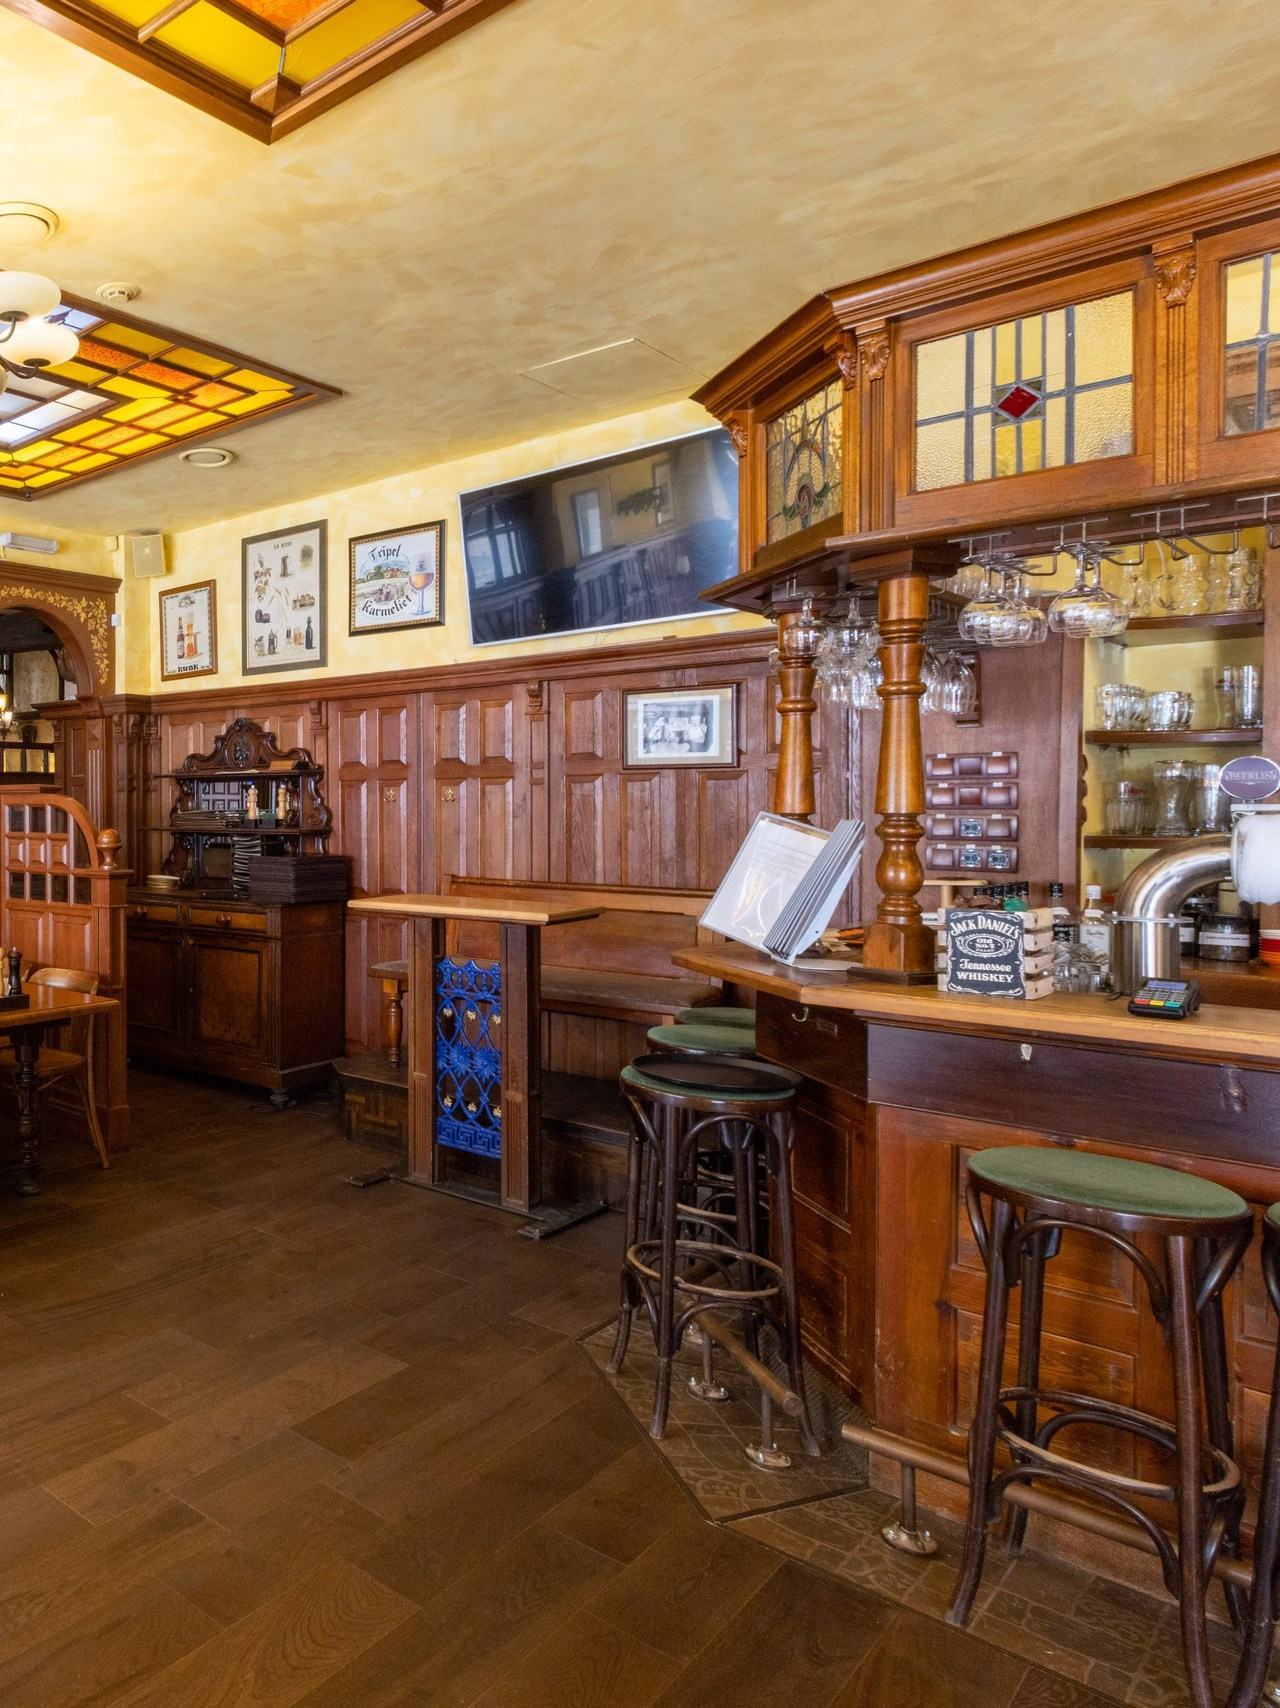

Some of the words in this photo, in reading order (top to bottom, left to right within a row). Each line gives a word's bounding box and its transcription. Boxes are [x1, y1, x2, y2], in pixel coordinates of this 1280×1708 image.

[368, 544, 402, 561] Tripel
[361, 595, 412, 617] Karmeliet
[950, 919, 975, 936] JACK
[977, 915, 1022, 939] DANIEL'S
[959, 958, 1012, 972] Tennessee
[956, 971, 1014, 982] WHISKEY
